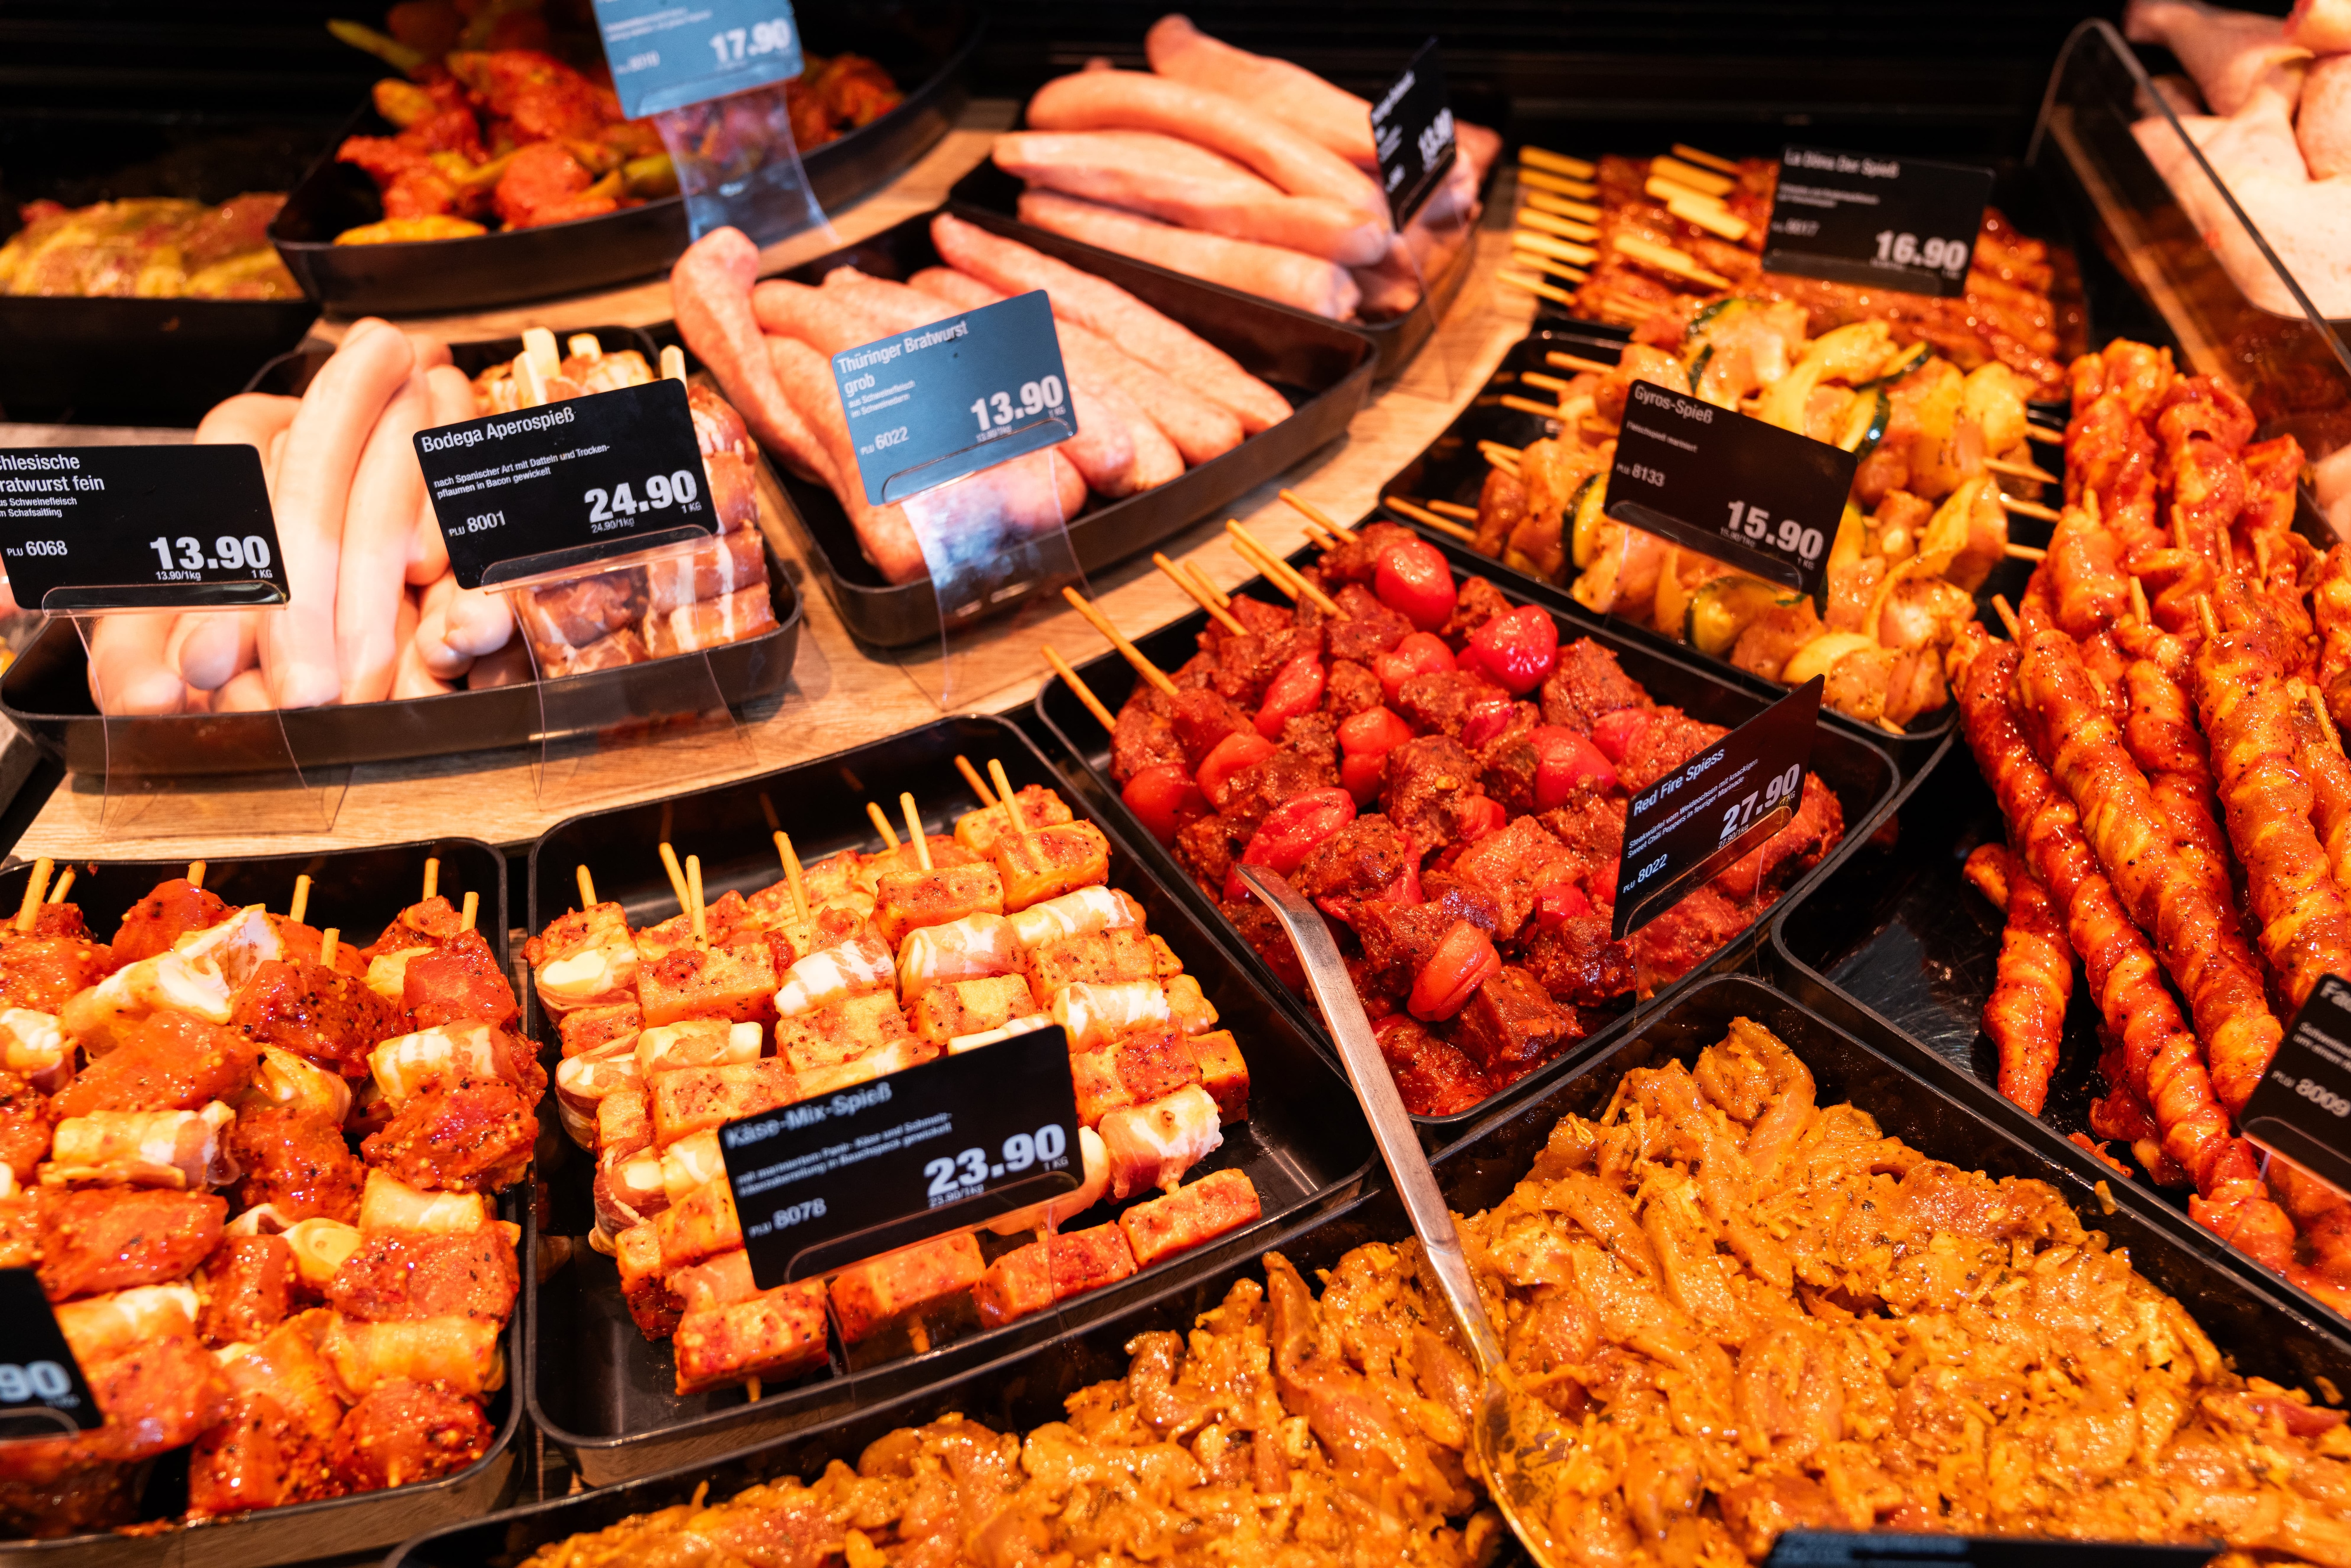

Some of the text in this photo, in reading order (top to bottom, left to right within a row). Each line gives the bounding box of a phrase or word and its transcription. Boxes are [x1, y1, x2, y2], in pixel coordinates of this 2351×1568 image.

[710, 18, 791, 63] 17.90
[1876, 229, 1969, 272] 16.90
[837, 320, 969, 374] Thüringer Bratwurst
[844, 372, 875, 398] grob
[970, 375, 1064, 431] 13.90
[1634, 384, 1713, 424] Gyros-Spieß
[422, 406, 575, 452] Bodega Aperospieß
[875, 426, 909, 449] 6022
[0, 454, 80, 470] hlesische
[434, 444, 610, 488] nach Spanischer Art mit Datteln und Trocken-
[1632, 463, 1665, 487] 8133
[9, 496, 77, 506] Schweinefleisch
[72, 475, 105, 491] fein
[437, 466, 552, 500] pflaumen in Bacon gewickelt
[584, 470, 697, 523] 24.90
[8, 507, 63, 518] Schafsaitling
[448, 510, 506, 537] PLU 8001
[590, 501, 702, 534] 24.90/1kg 1 KG
[1728, 500, 1824, 560] 15.90
[7, 540, 68, 557] PLU 6068
[150, 535, 270, 570] 13.90
[156, 569, 273, 581] 13.90/1kg 1 KG
[1633, 749, 1725, 817] Red Fire Spiess
[1720, 763, 1800, 840] 27.90
[1787, 790, 1795, 802] KG
[1627, 776, 1744, 859] Sweet Chili Peppers in feuriger Marinade
[1629, 758, 1759, 849] Steakwürfel vom Weideochsen mit knackigen
[1623, 853, 1668, 893] PLU 8022
[724, 1081, 892, 1149] Käse-Mix-Spieß
[2295, 1078, 2351, 1118] 8009
[923, 1124, 1066, 1198] 23.90
[1052, 1156, 1069, 1170] KG
[772, 1198, 827, 1230] 8078
